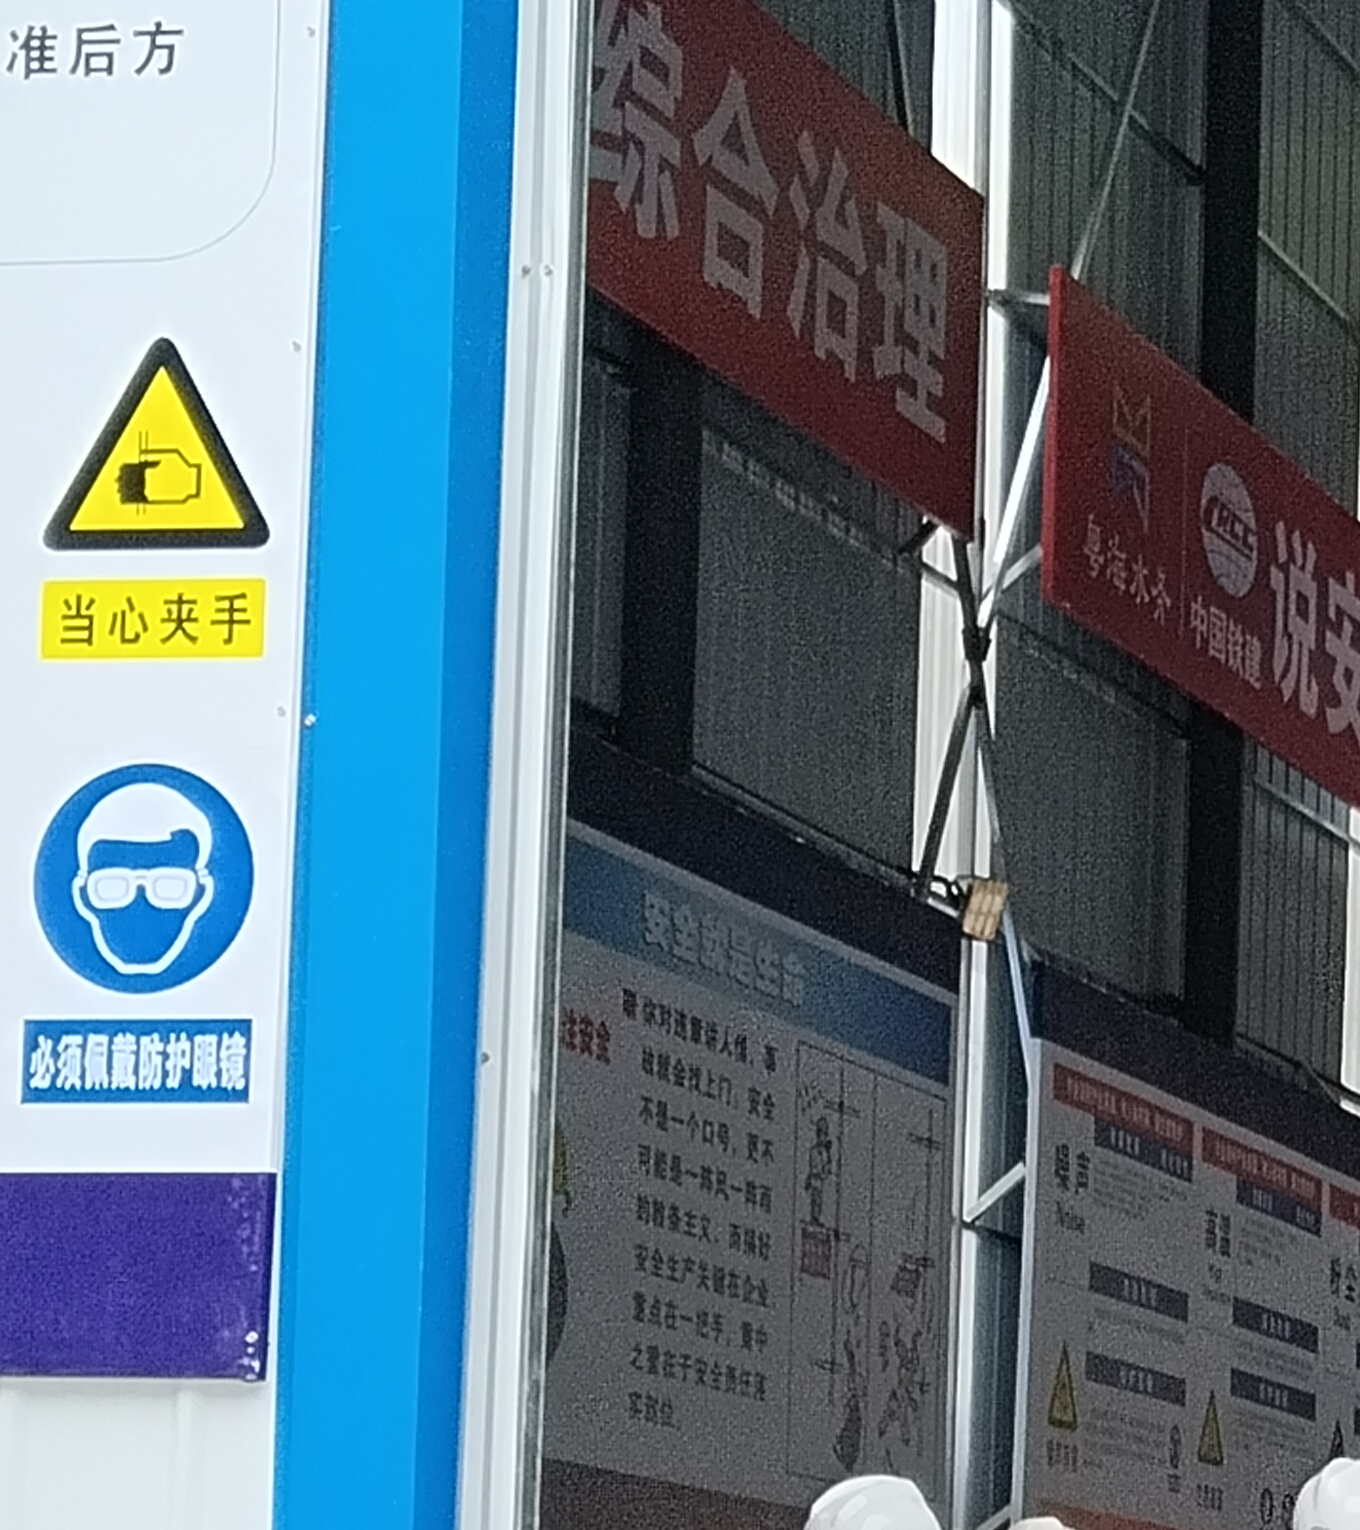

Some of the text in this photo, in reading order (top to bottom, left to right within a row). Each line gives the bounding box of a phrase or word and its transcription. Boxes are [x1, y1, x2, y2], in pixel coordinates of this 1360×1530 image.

[5, 20, 186, 80] 准后方
[591, 2, 948, 443] 综合治理
[57, 591, 253, 648] 当心夹手
[1190, 597, 1263, 696] 中国铁建
[28, 1029, 248, 1093] 必须佩戴防护眼镜
